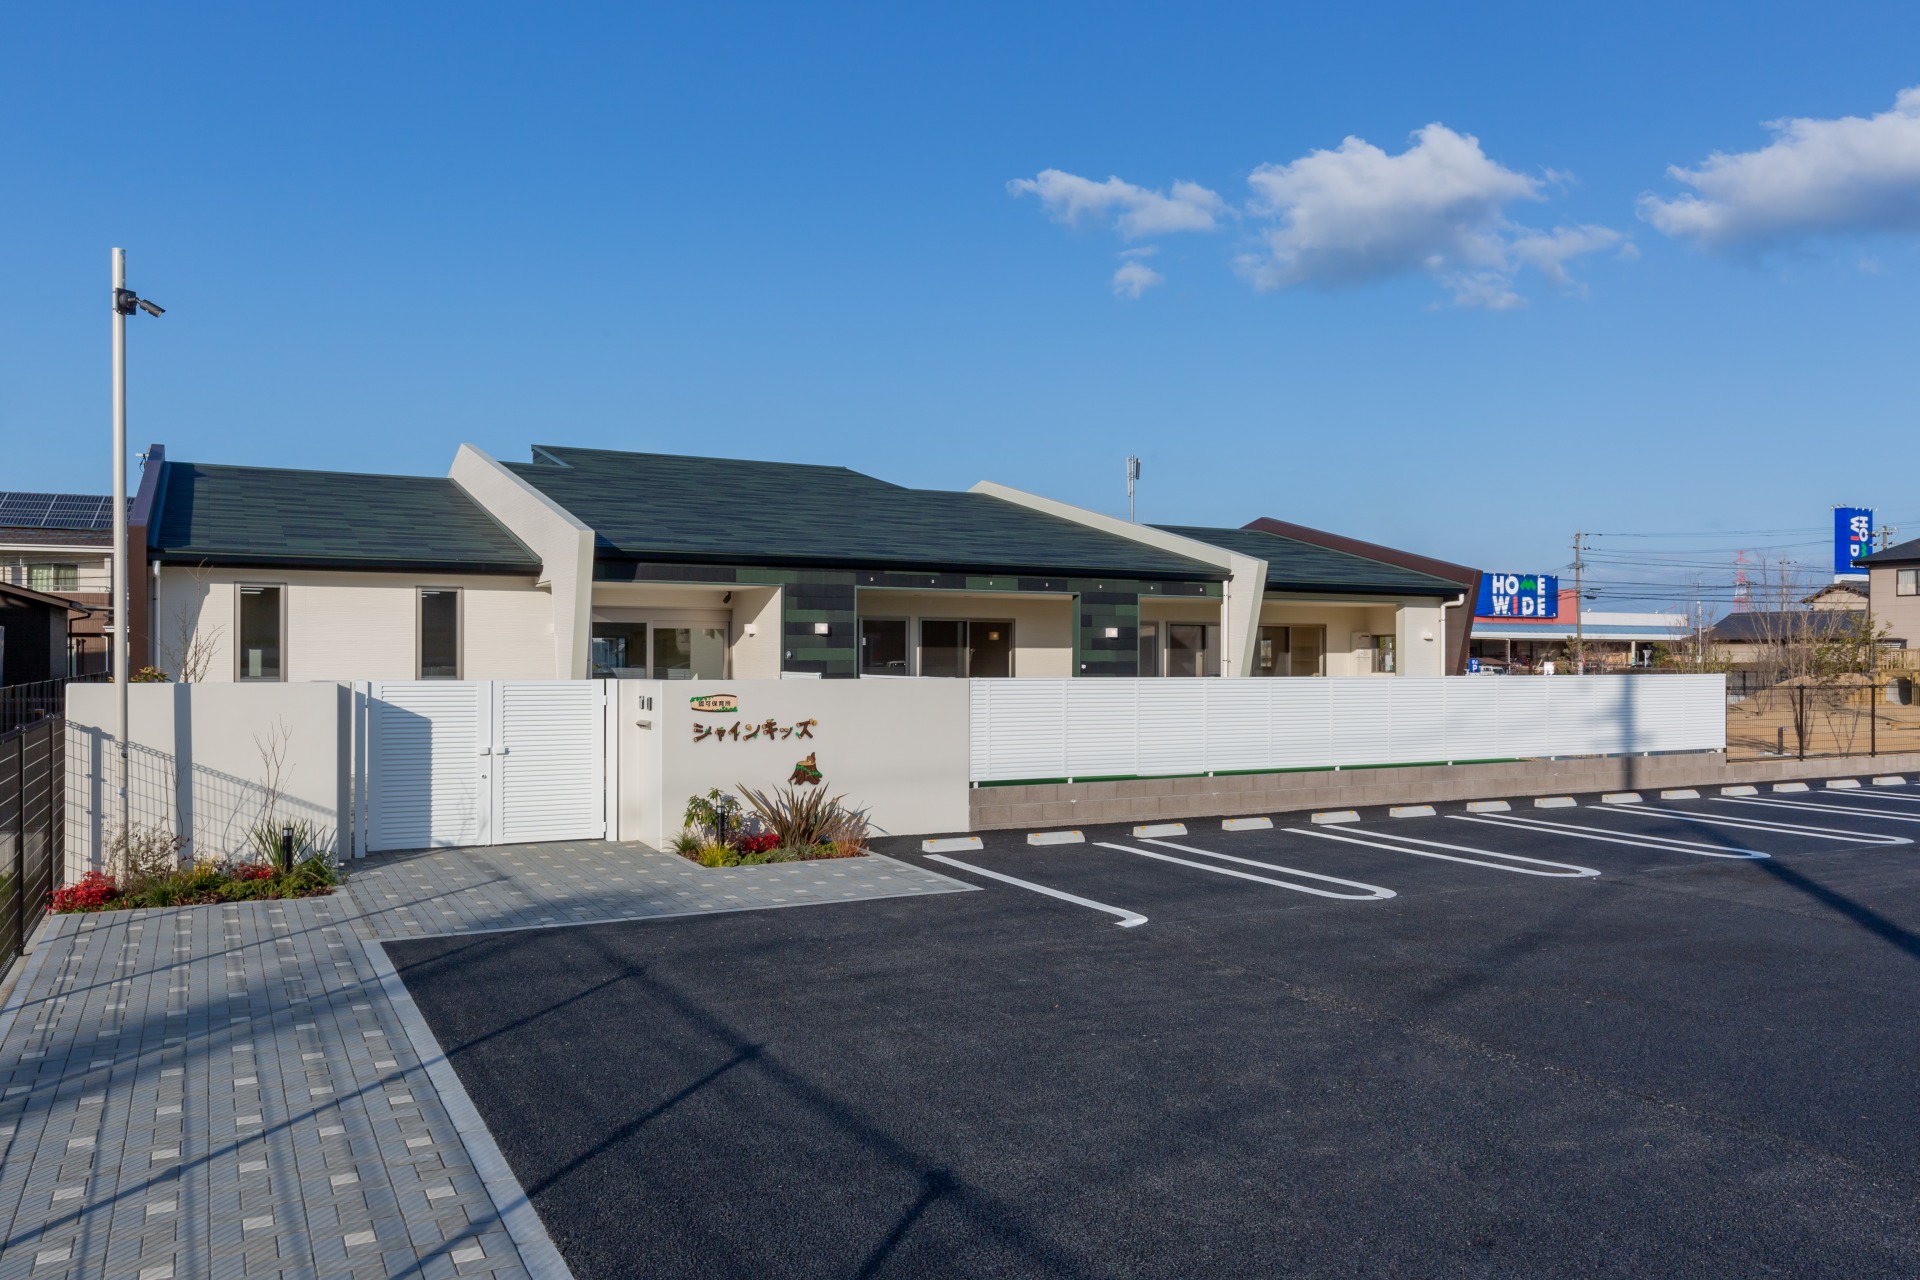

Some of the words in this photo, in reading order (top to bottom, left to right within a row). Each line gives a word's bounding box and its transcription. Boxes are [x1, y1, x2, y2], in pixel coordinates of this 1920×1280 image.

[1859, 516, 1869, 566] HOM
[1492, 576, 1546, 596] HOME
[1492, 596, 1546, 616] WIDE
[1472, 664, 1478, 672] P
[693, 719, 817, 742] シャインキッズ
